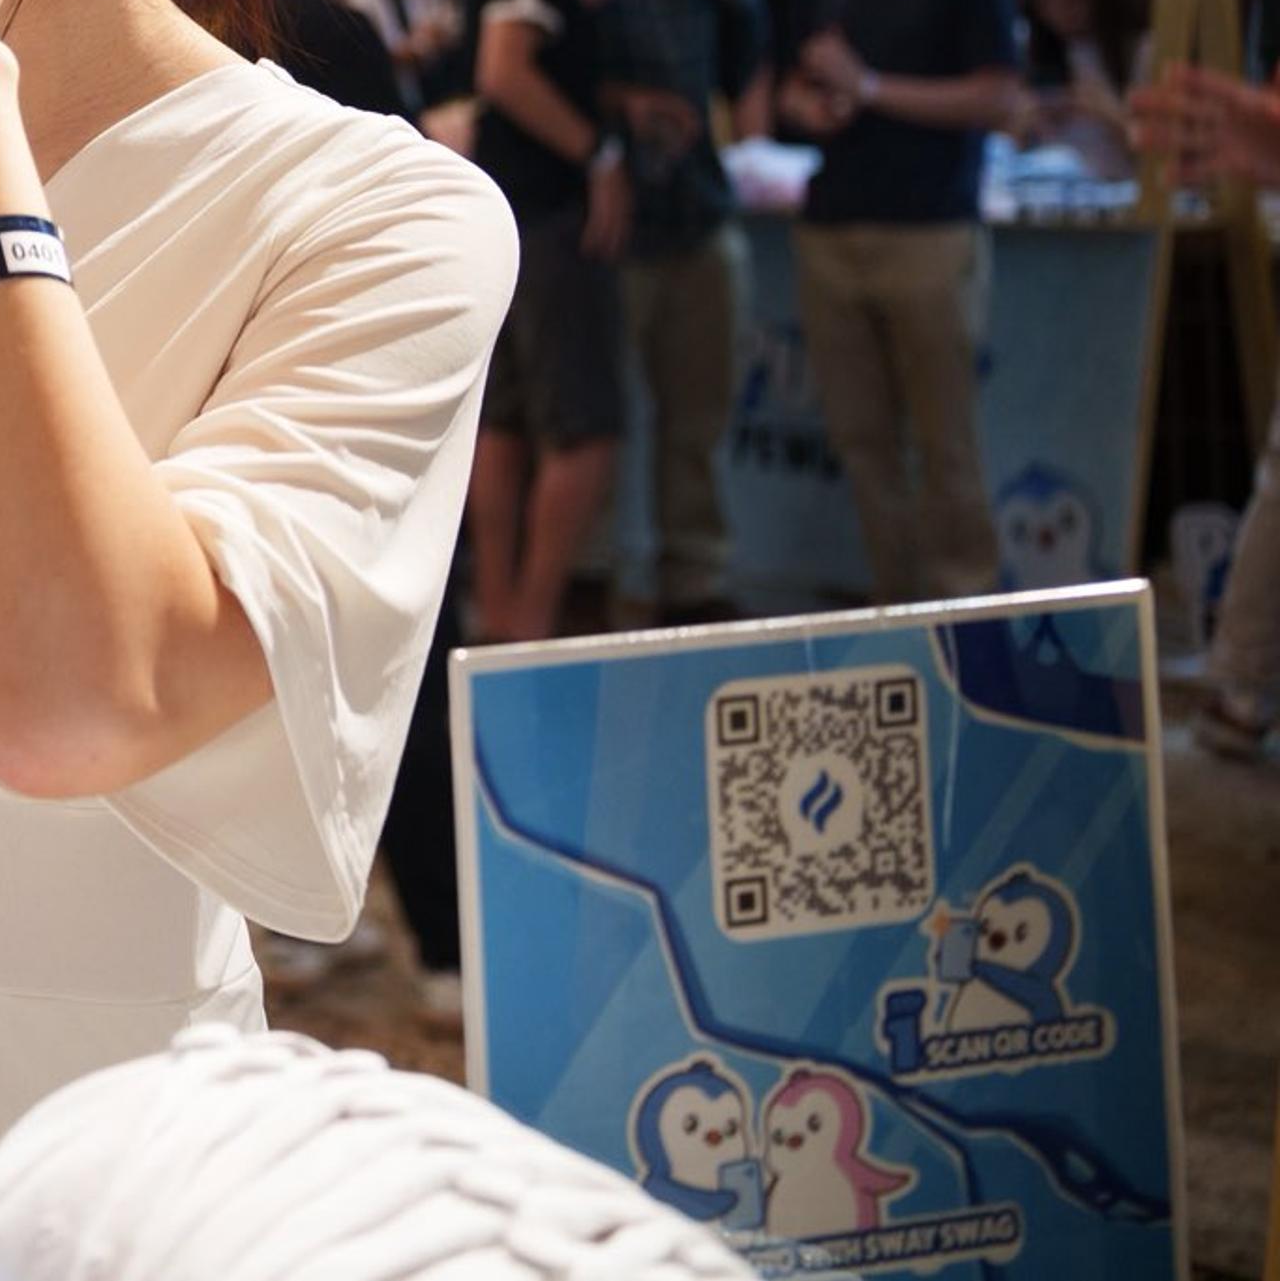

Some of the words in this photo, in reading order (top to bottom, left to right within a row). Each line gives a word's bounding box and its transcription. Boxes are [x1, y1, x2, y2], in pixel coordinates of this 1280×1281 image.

[925, 1033, 990, 1065] SCAN
[993, 1028, 1030, 1058] QR
[1033, 1020, 1098, 1052] CODE
[865, 1226, 938, 1261] SWAY
[939, 1214, 1016, 1250] SWAG
